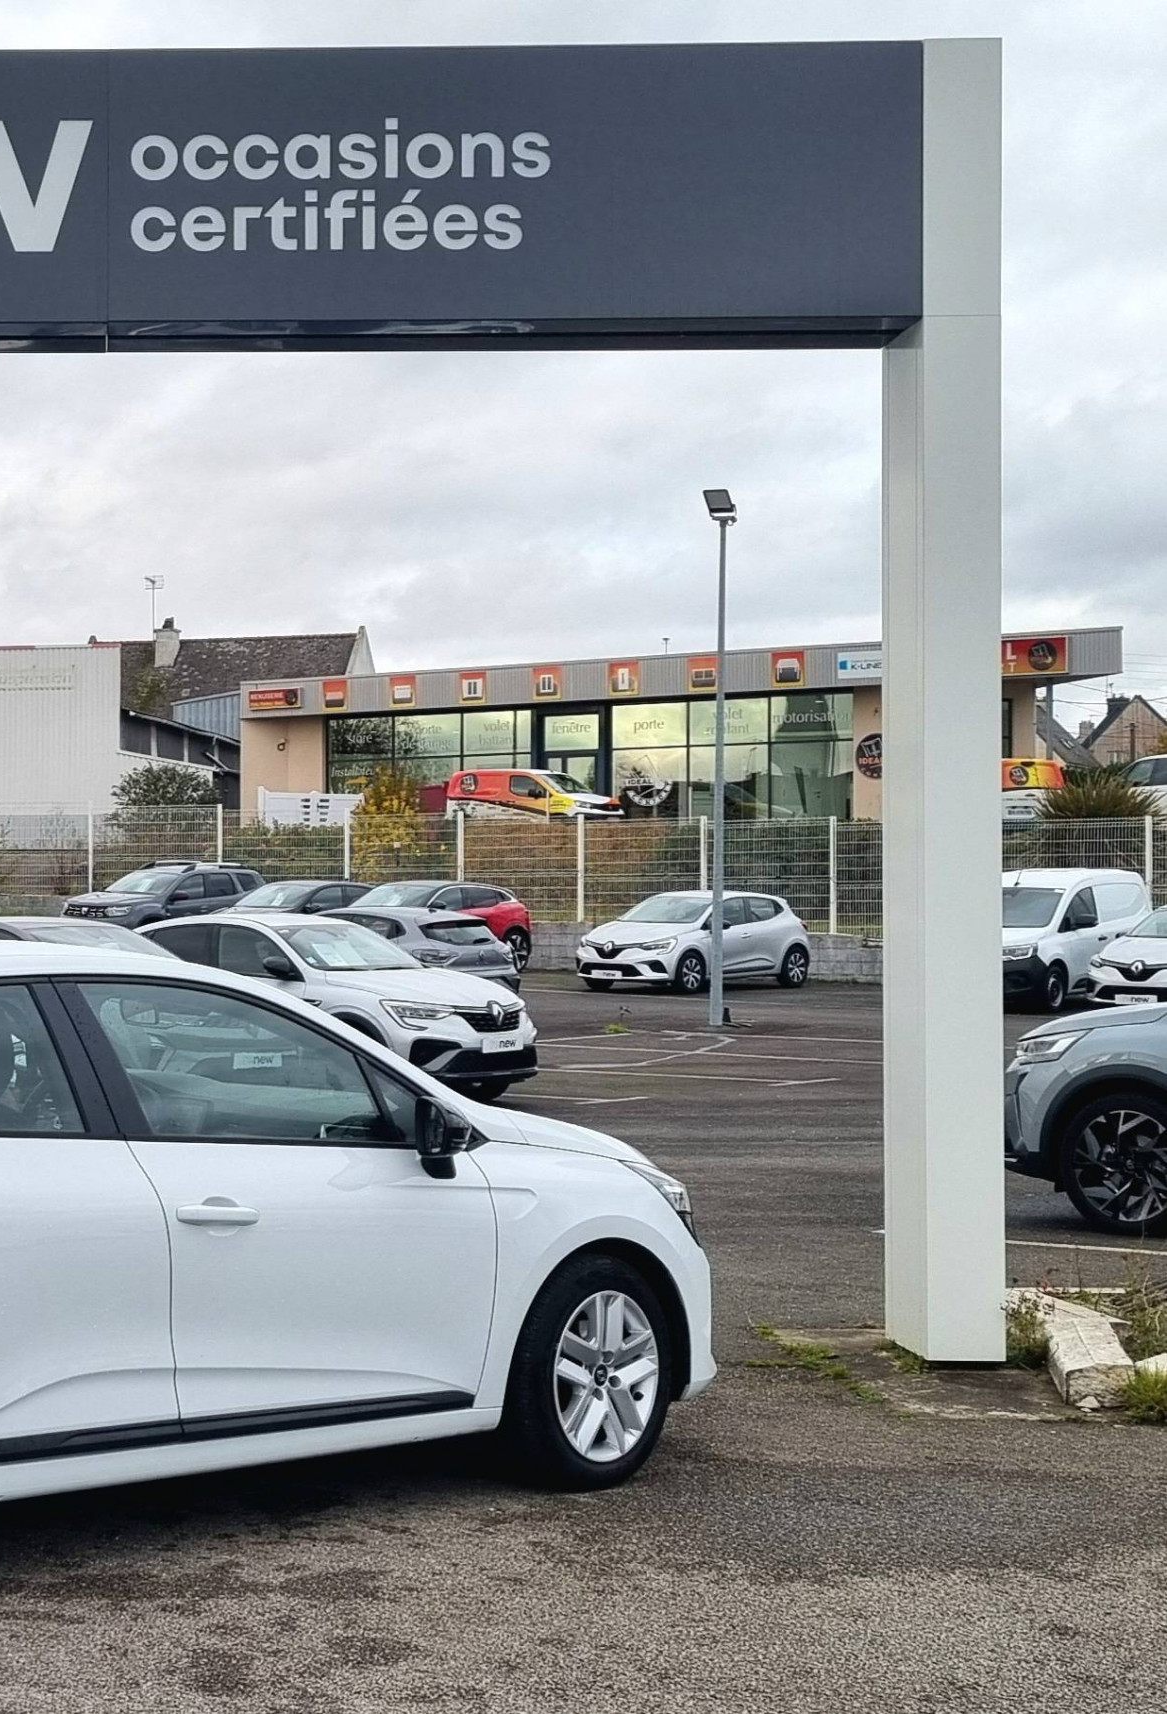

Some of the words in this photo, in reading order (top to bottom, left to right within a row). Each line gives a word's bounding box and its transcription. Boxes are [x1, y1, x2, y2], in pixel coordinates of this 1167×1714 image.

[130, 117, 551, 180] occasions
[130, 188, 523, 252] certifiées
[551, 721, 591, 735] fenêtre
[633, 718, 665, 734] porte
